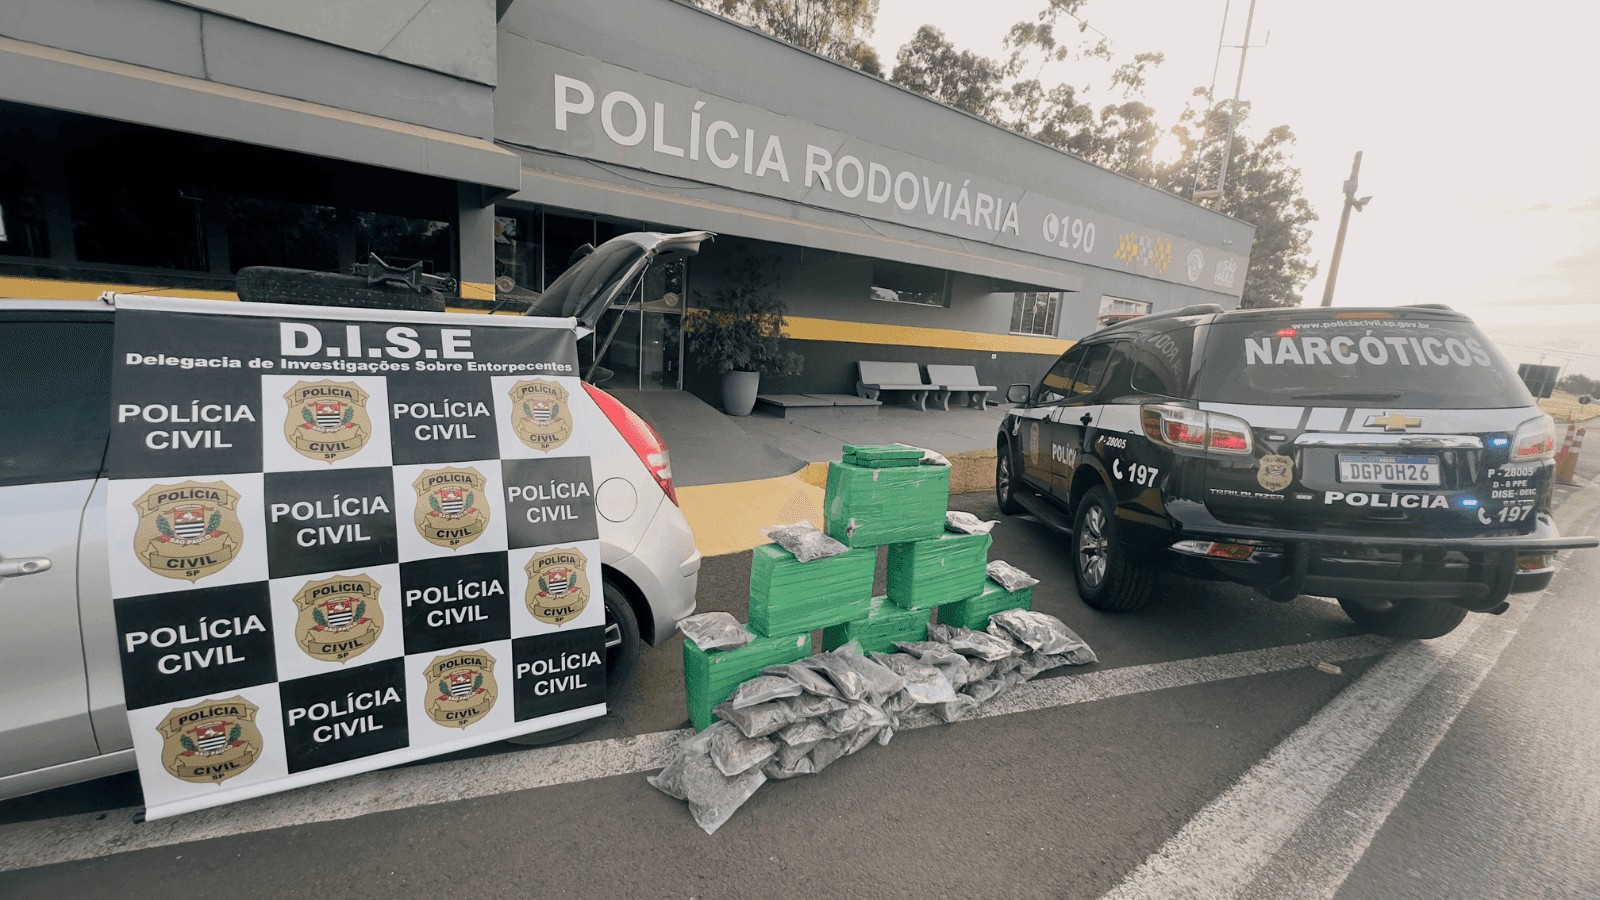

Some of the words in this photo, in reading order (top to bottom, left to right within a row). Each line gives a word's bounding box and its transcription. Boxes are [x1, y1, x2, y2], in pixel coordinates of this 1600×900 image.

[554, 74, 790, 183] POLÍCIA
[804, 144, 1020, 236] RODOVIÁRIA
[1058, 215, 1096, 253] 190
[1291, 319, 1430, 330] www.policiacivil.sp.gov.br
[280, 323, 475, 360] D.I.S.E
[1244, 330, 1492, 367] NARCÓTICOS
[126, 353, 242, 370] Delegacia
[249, 358, 275, 369] de
[280, 358, 411, 374] Investigações
[415, 361, 463, 372] Sobre
[467, 362, 573, 374] Entorpecentes
[302, 386, 353, 398] POLÍCIA
[119, 399, 256, 423] POLÍCIA
[393, 399, 491, 420] POLÍCIA
[146, 430, 233, 450] CIVIL
[414, 424, 477, 441] CIVIL
[530, 434, 559, 442] CIVIL
[309, 442, 351, 452] CIVIL
[428, 473, 473, 486] POLÍCIA
[1128, 462, 1159, 488] 197
[1488, 468, 1496, 479] P
[1503, 467, 1534, 477] 28005
[157, 489, 221, 504] POLÍCIA
[507, 480, 591, 503] POLÍCIA
[1209, 488, 1285, 501] TRAILBLAZER
[1324, 491, 1450, 509] POLÍCIA
[270, 495, 390, 522] POLÍCIA
[527, 505, 579, 524] CIVIL
[1498, 505, 1533, 523] 197
[296, 523, 372, 548] CIVIL
[436, 528, 472, 538] CIVIL
[166, 556, 218, 568] CIVIL
[312, 582, 364, 599] POLÍCIA
[406, 580, 505, 608] POLÍCIA
[426, 606, 489, 628] CIVIL
[543, 606, 575, 616] CIVIL
[125, 615, 267, 652] POLÍCIA
[321, 640, 363, 653] CIVIL
[157, 645, 246, 675] CIVIL
[439, 657, 483, 672] POLÍCIA
[517, 651, 602, 680] POLÍCIA
[534, 675, 588, 696] CIVIL
[179, 706, 239, 725] POLÍCIA
[288, 687, 402, 727] POLÍCIA
[446, 708, 480, 720] CIVIL
[313, 718, 384, 743] CIVIL
[193, 761, 240, 776] CIVIL
